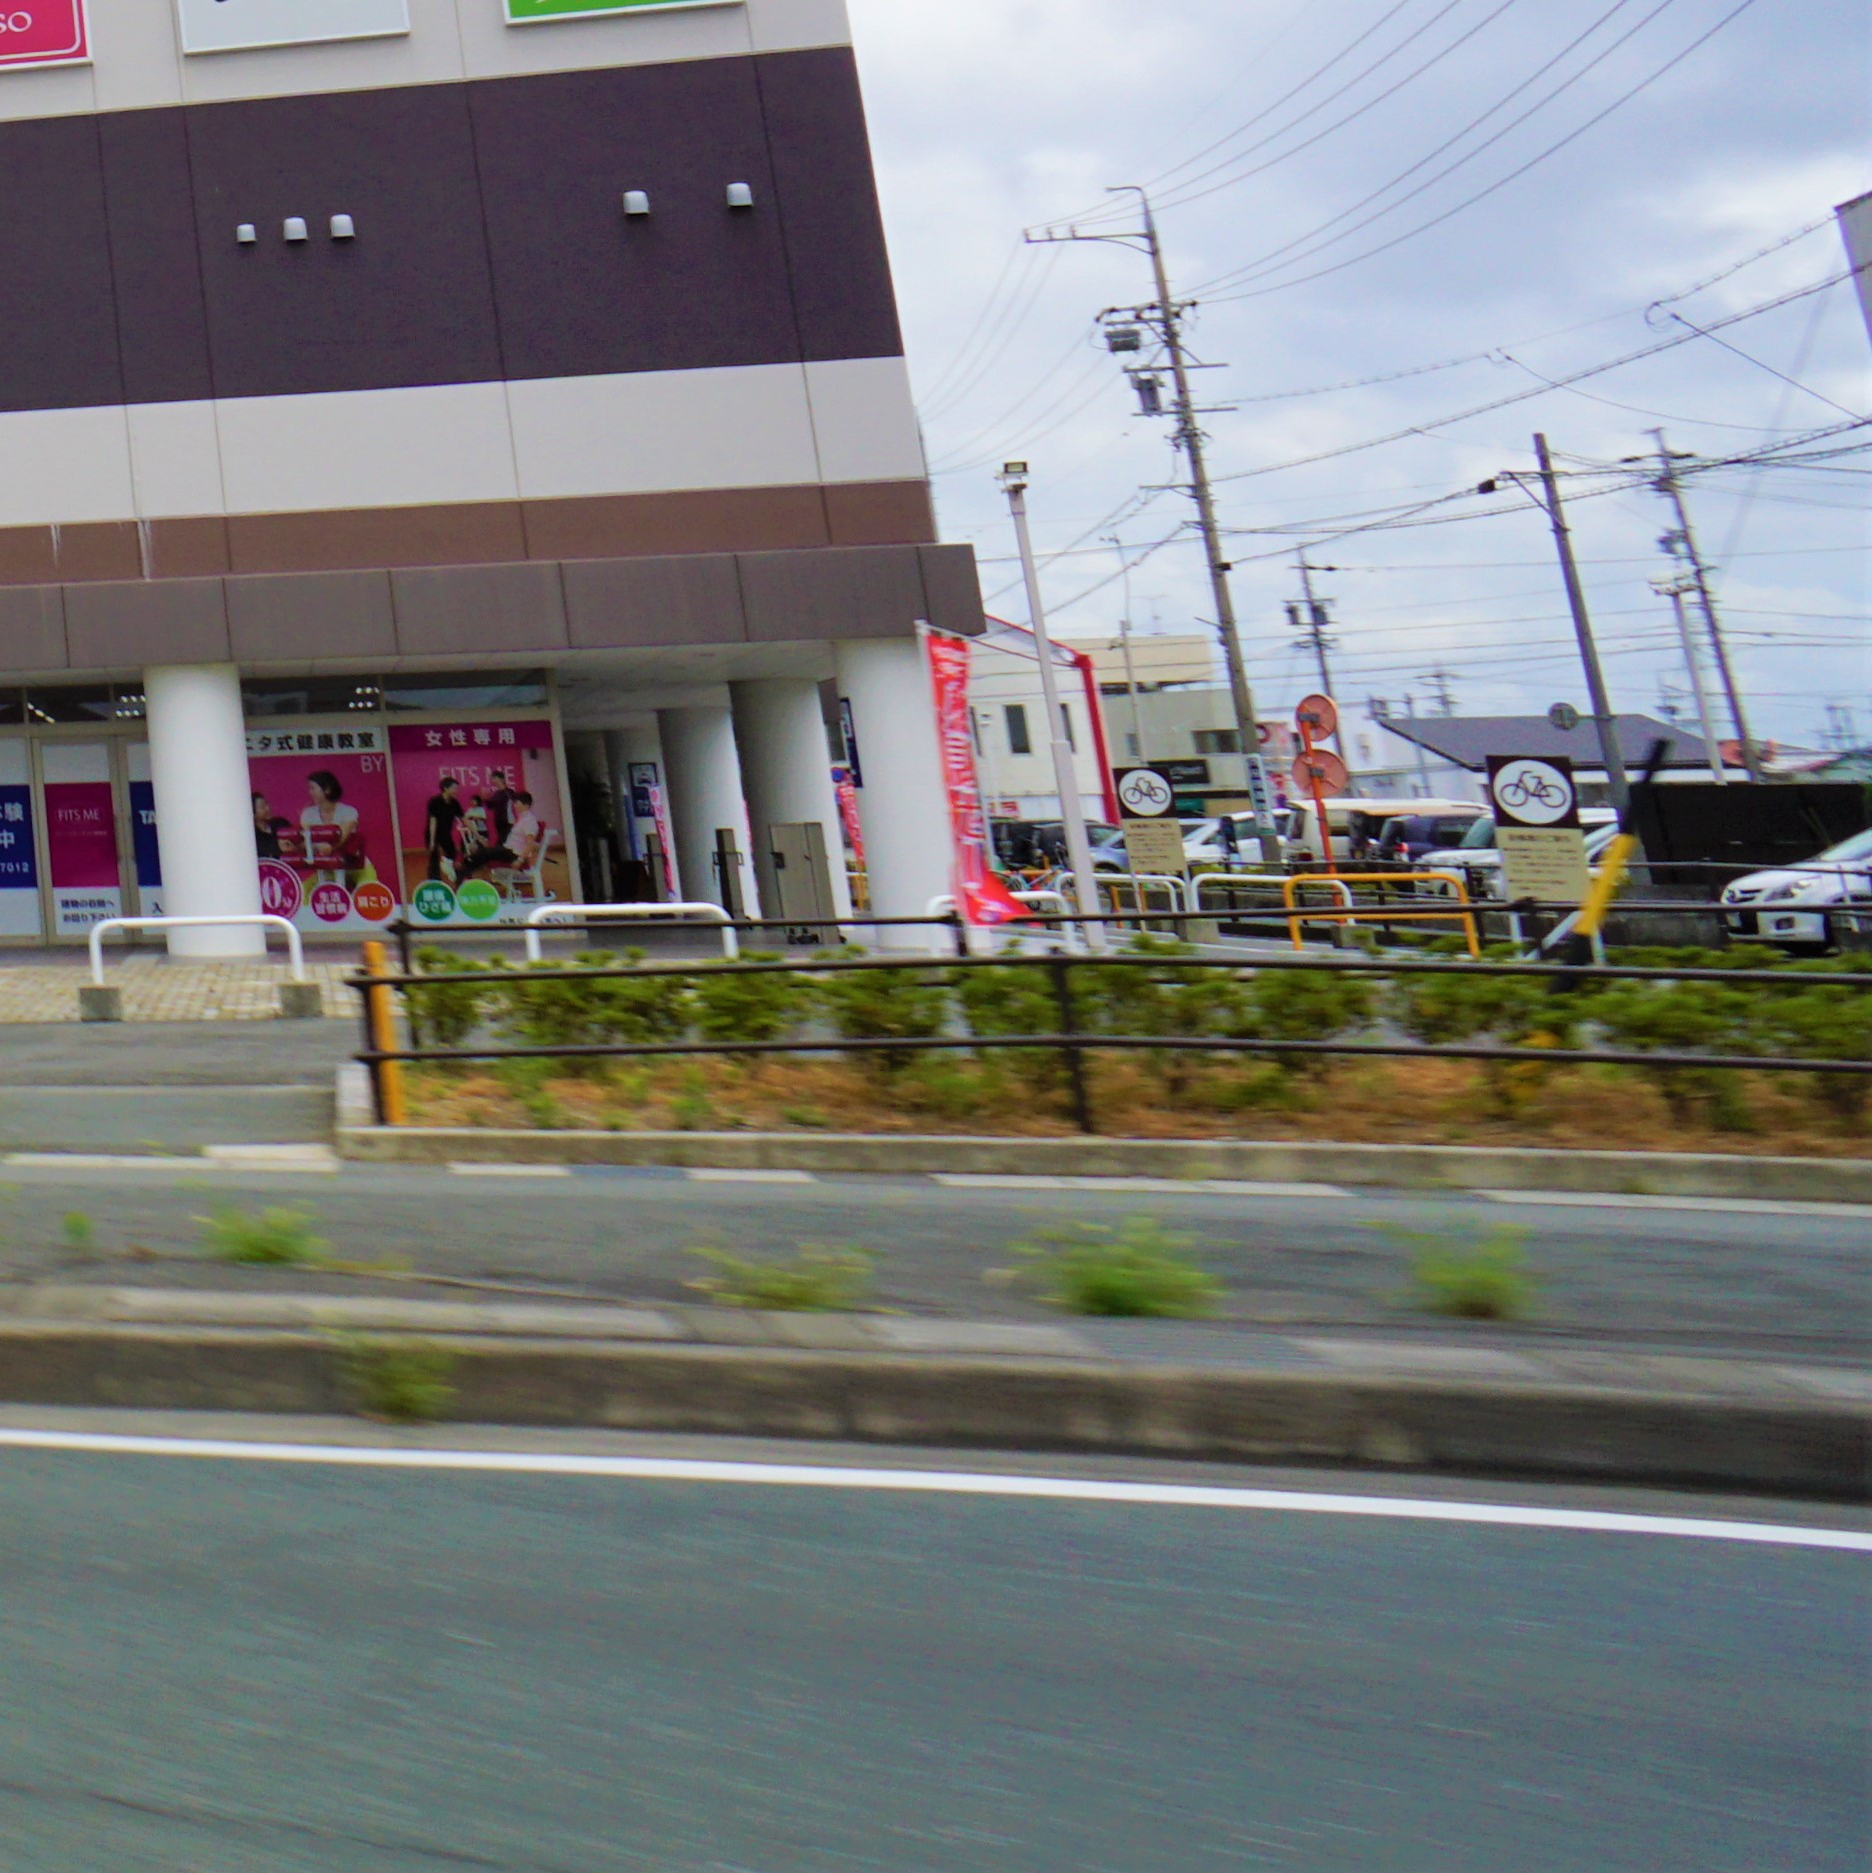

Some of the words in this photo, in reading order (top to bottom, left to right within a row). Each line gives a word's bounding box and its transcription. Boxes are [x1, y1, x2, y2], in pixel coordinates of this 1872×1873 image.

[424, 727, 515, 747] 女性専用
[360, 755, 384, 773] BY
[58, 809, 81, 822] FITS
[84, 808, 101, 820] ME
